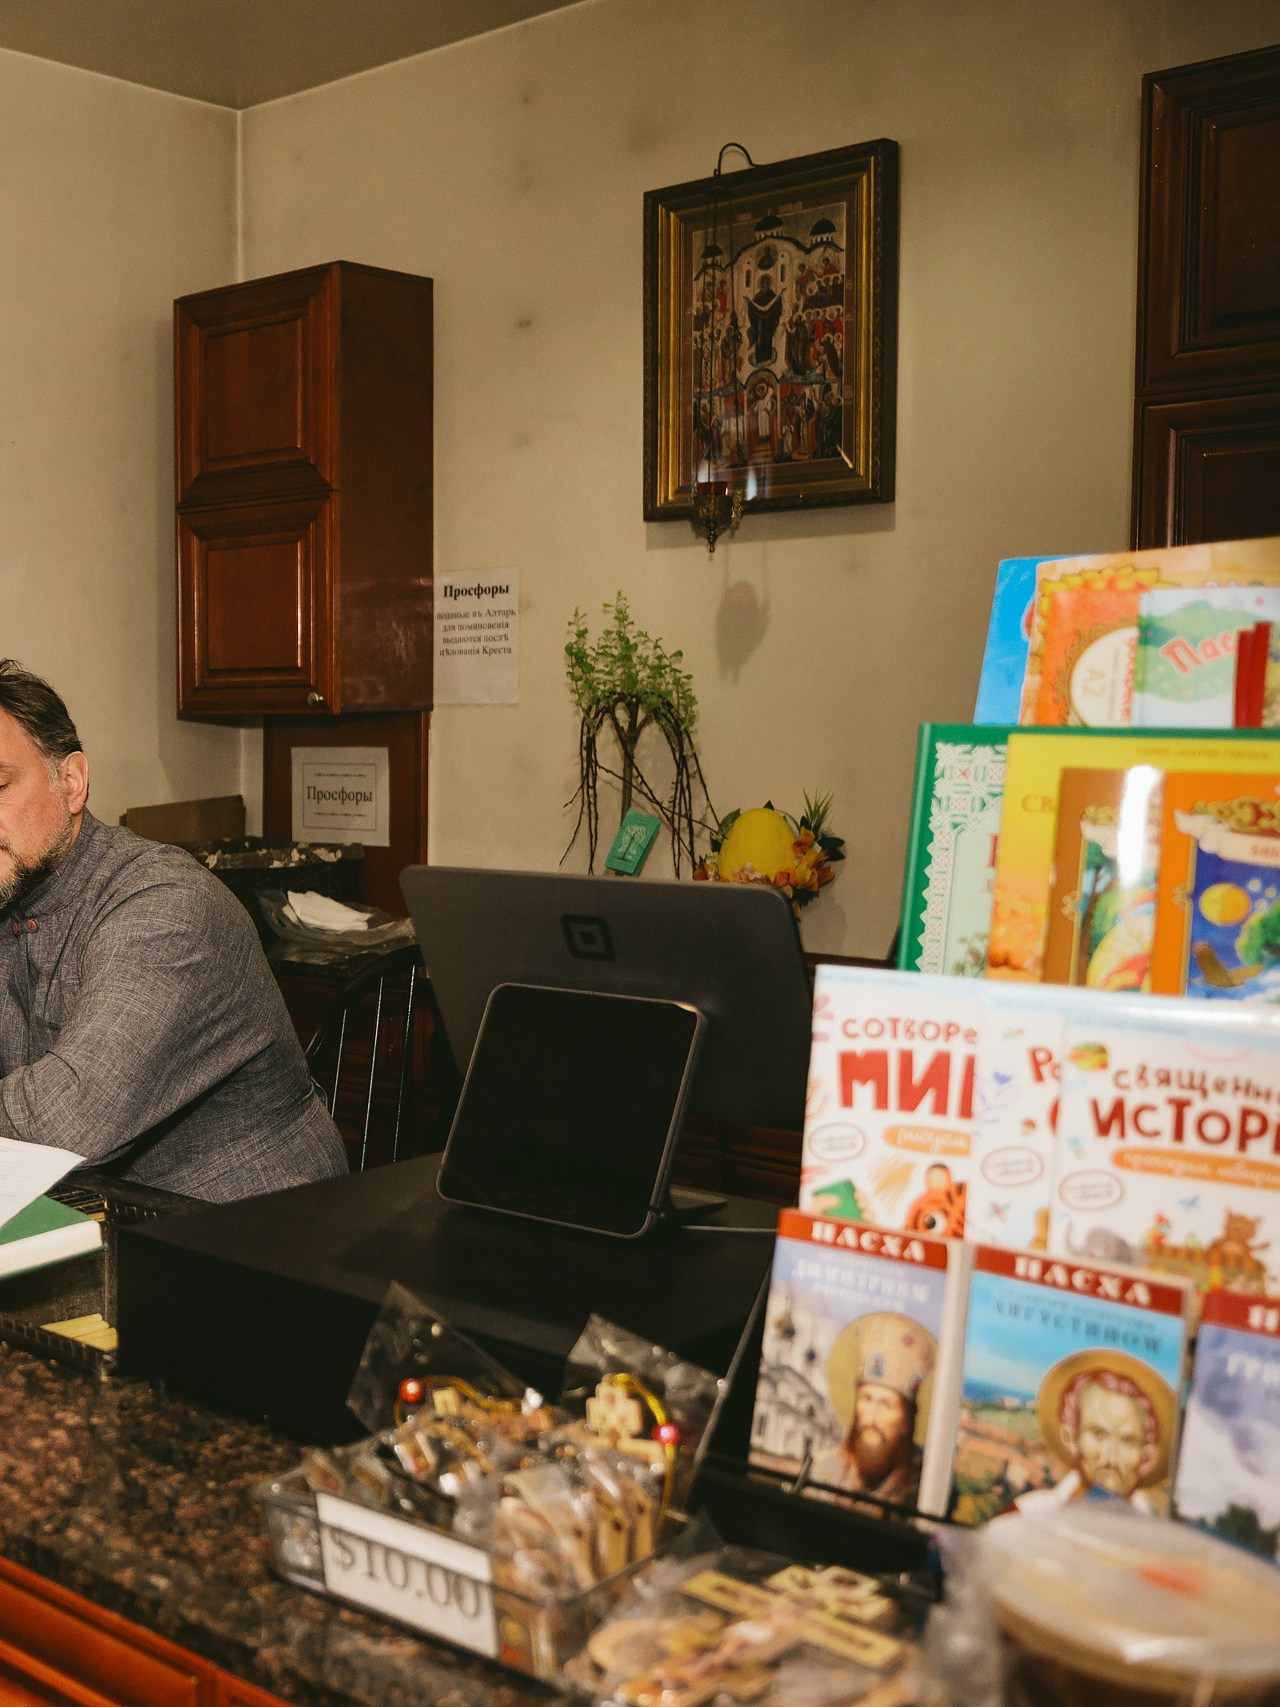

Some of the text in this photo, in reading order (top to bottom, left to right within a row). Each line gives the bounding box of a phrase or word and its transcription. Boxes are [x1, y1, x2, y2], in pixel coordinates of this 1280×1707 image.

[443, 583, 510, 600] Просфоры
[484, 608, 516, 618] Алтарь
[442, 624, 456, 632] для
[442, 636, 482, 644] выдаются
[482, 646, 512, 656] Креста
[306, 785, 373, 805] Просфоры
[811, 1221, 926, 1263] ПАСХА
[1014, 1255, 1152, 1307] ПАСХА
[328, 1526, 481, 1619] $10.00
